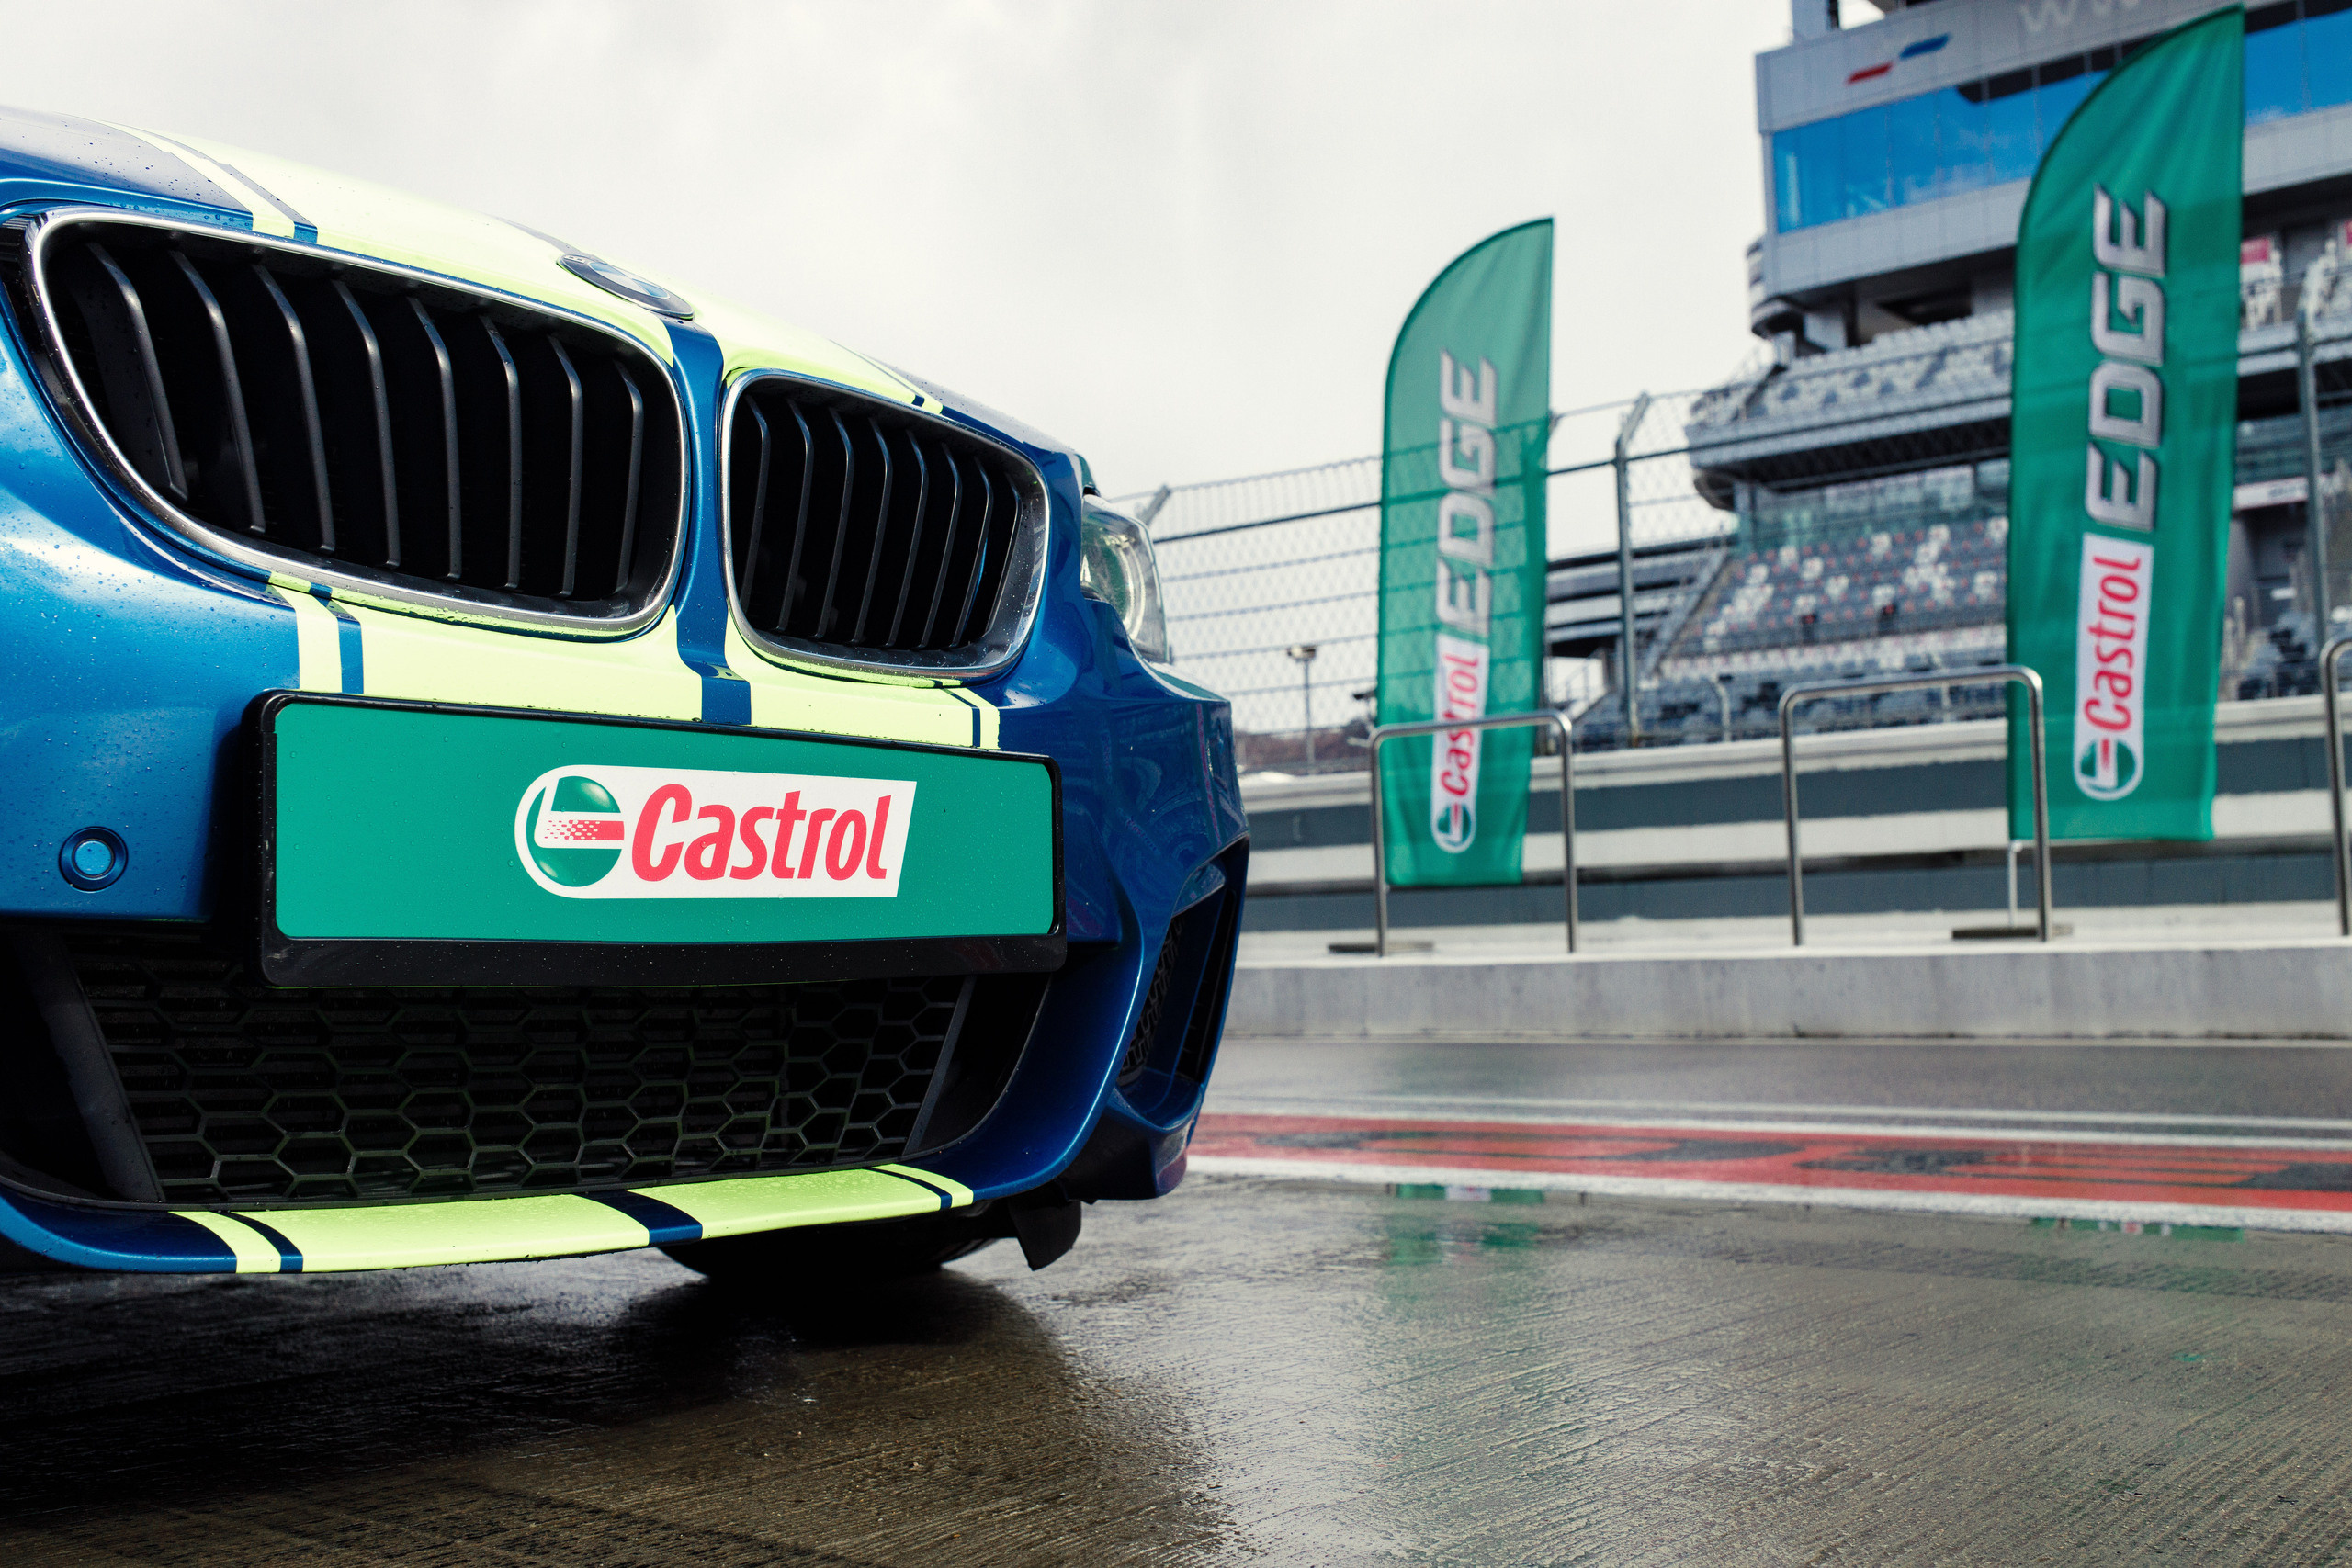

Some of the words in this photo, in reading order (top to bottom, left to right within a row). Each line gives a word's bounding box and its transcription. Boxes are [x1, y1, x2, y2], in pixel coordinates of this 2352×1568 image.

[2085, 184, 2166, 532] EDGE
[1436, 348, 1497, 637] EDGE
[2084, 556, 2142, 733] Castrol
[632, 784, 892, 882] Castrol
